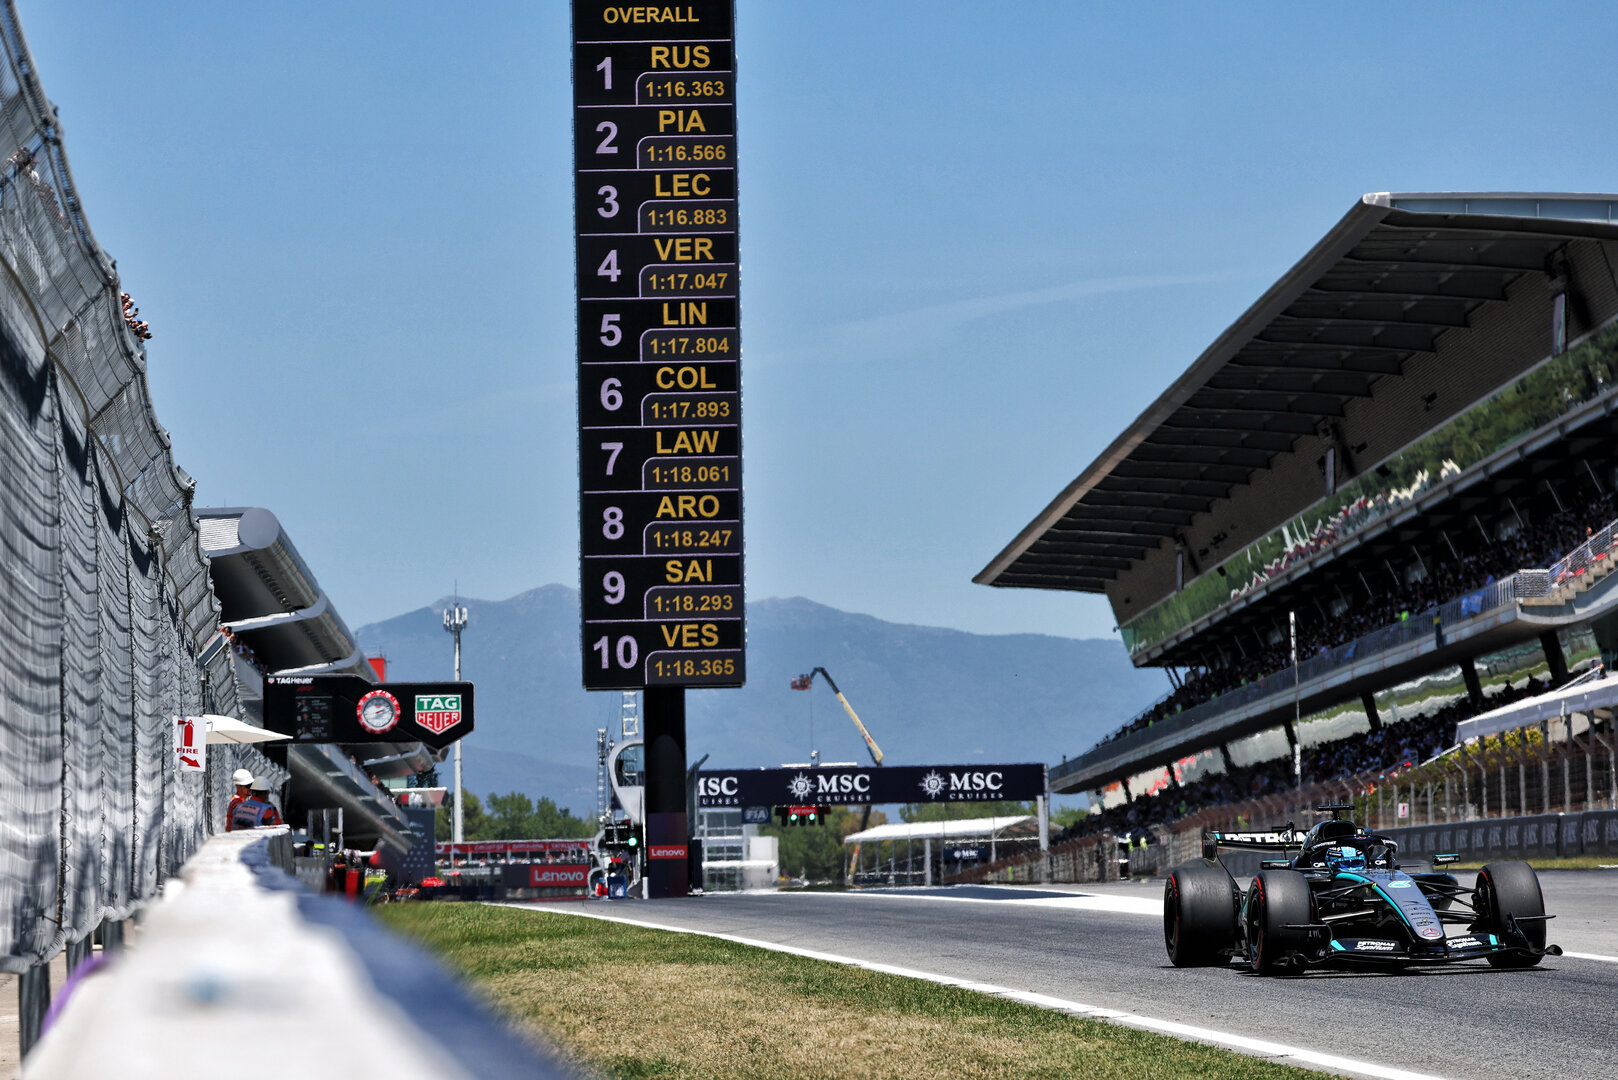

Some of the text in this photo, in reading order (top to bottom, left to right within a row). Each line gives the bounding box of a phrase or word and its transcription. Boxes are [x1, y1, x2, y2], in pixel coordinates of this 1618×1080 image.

[604, 7, 699, 23] OVERALL
[652, 46, 710, 68] RUS
[597, 57, 612, 89] 1
[646, 81, 724, 97] 1:16.363
[659, 110, 706, 132] PIA
[596, 121, 618, 153] 2
[647, 145, 725, 161] 1:16.566
[655, 174, 710, 196] LEC
[598, 185, 619, 218] 3
[649, 209, 726, 225] 1:16.883
[654, 238, 714, 260] VER
[598, 250, 621, 282] 4
[650, 273, 727, 289] 1:17.047
[663, 302, 706, 325] LIN
[600, 314, 622, 346] 5
[651, 338, 729, 354] 1:17.804
[656, 367, 716, 389] COL
[601, 378, 623, 410] 6
[652, 402, 729, 418] 1:17.893
[657, 431, 719, 454] LAW
[601, 442, 623, 475] 7
[653, 466, 728, 482] 1:18.061
[656, 495, 719, 517] ARO
[603, 507, 624, 539] 8
[654, 530, 731, 547] 1:18.247
[666, 560, 712, 583] SAI
[603, 571, 625, 604] 9
[655, 595, 732, 611] 1:18.293
[661, 624, 718, 647] VES
[594, 635, 638, 669] 10
[656, 659, 734, 676] 1:18.365
[419, 698, 458, 710] TAG
[418, 711, 460, 732] HEUER
[816, 774, 870, 793] MSC
[949, 772, 1003, 790] MSC
[651, 848, 685, 857] Lenovo
[534, 869, 584, 882] Lenovo
